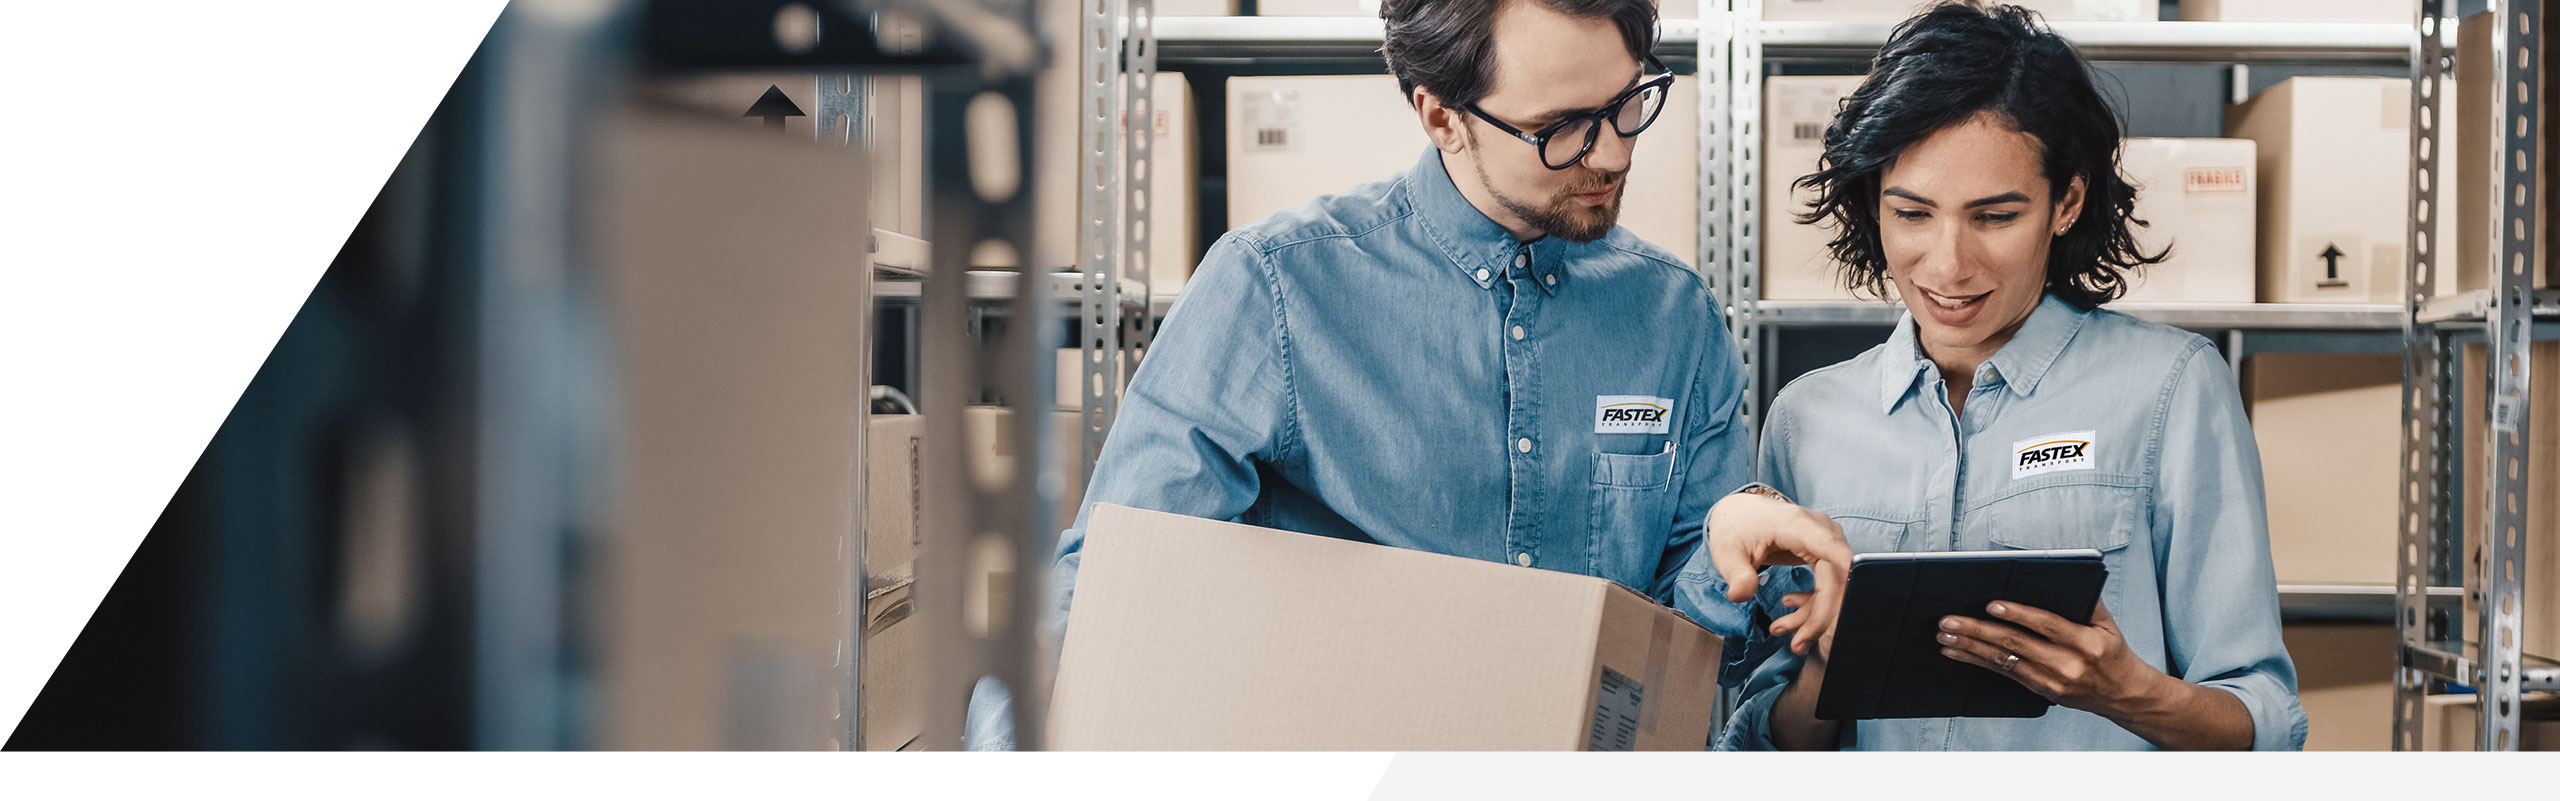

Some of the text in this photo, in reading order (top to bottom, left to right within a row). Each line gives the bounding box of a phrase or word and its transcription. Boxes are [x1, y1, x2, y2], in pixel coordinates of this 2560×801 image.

[1602, 408, 1667, 422] FASTEX
[2019, 442, 2088, 466] FASTEX
[2019, 458, 2084, 471] TRANSPORT
